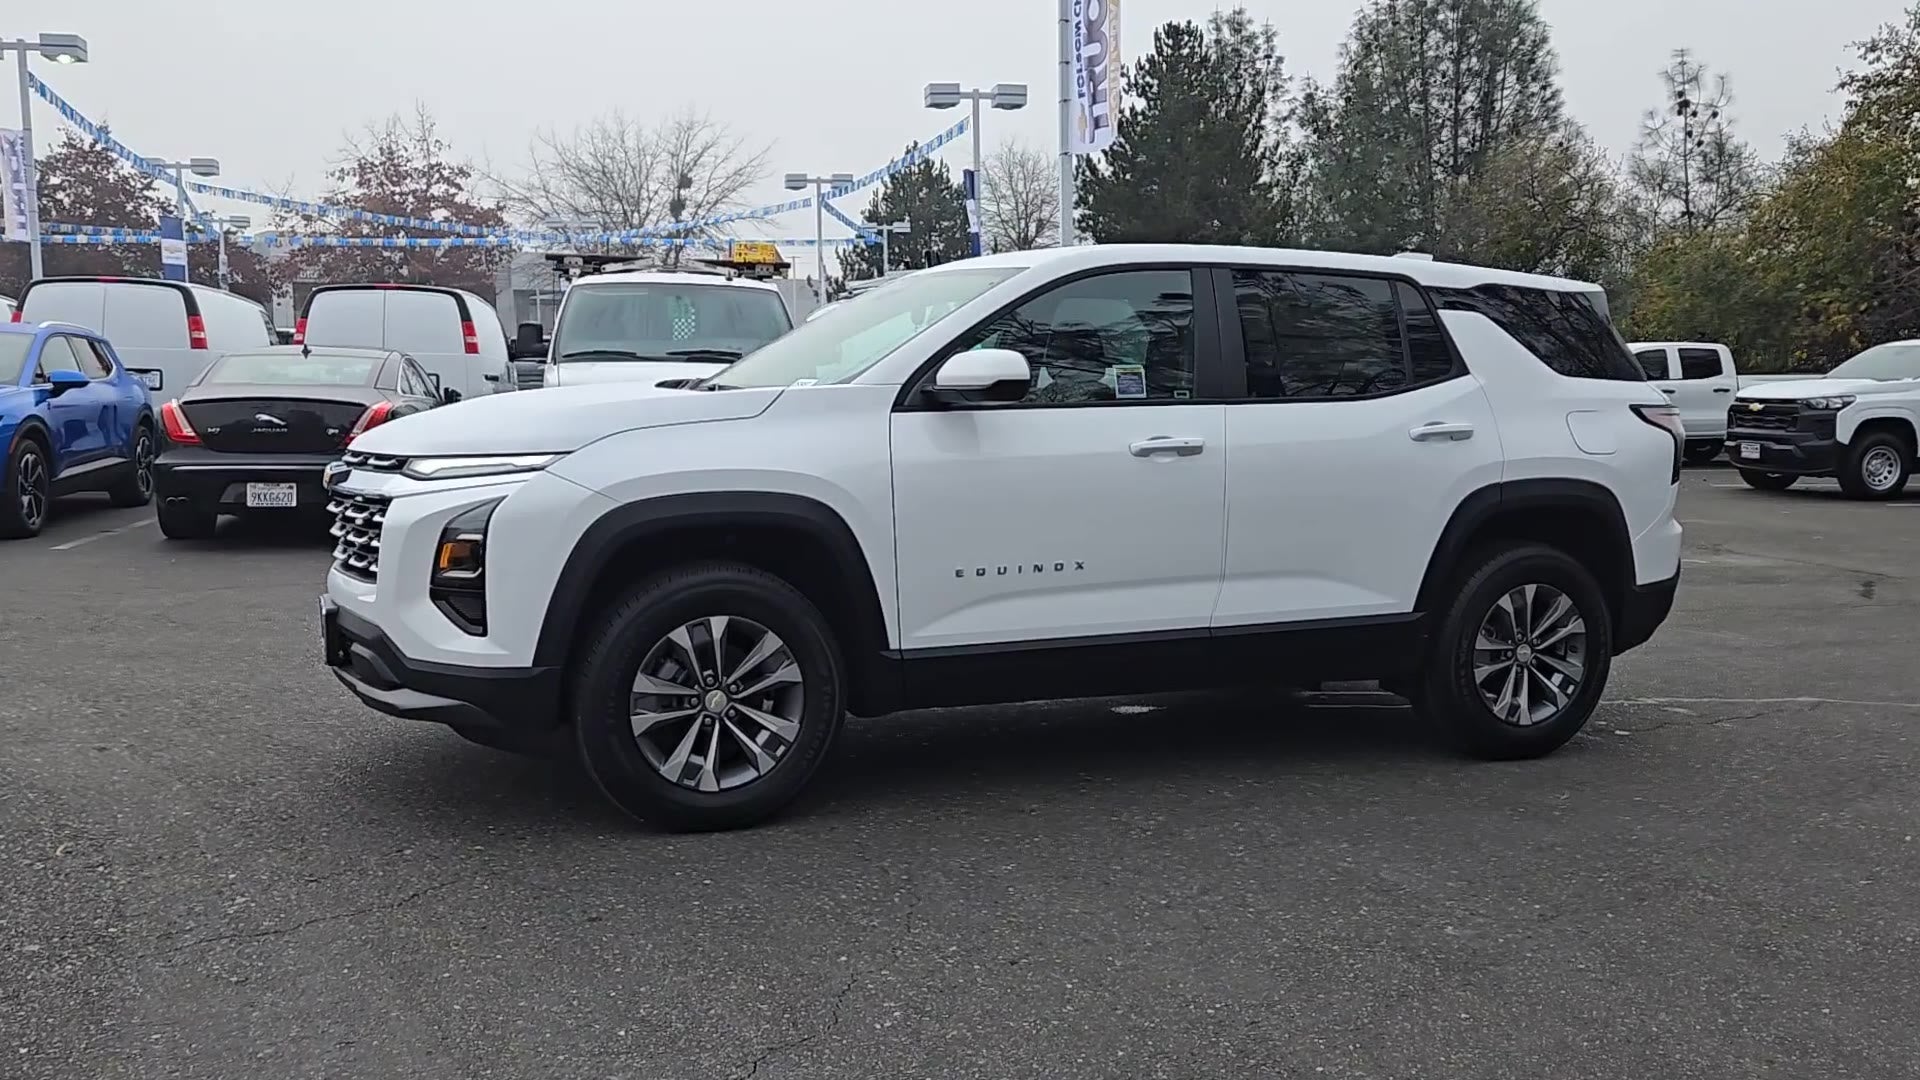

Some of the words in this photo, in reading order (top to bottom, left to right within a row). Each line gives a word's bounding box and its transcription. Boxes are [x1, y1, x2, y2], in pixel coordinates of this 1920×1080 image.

[1073, 20, 1086, 99] FOLSOM
[251, 491, 293, 503] 9KKG620
[955, 561, 1085, 578] EQUINOX
